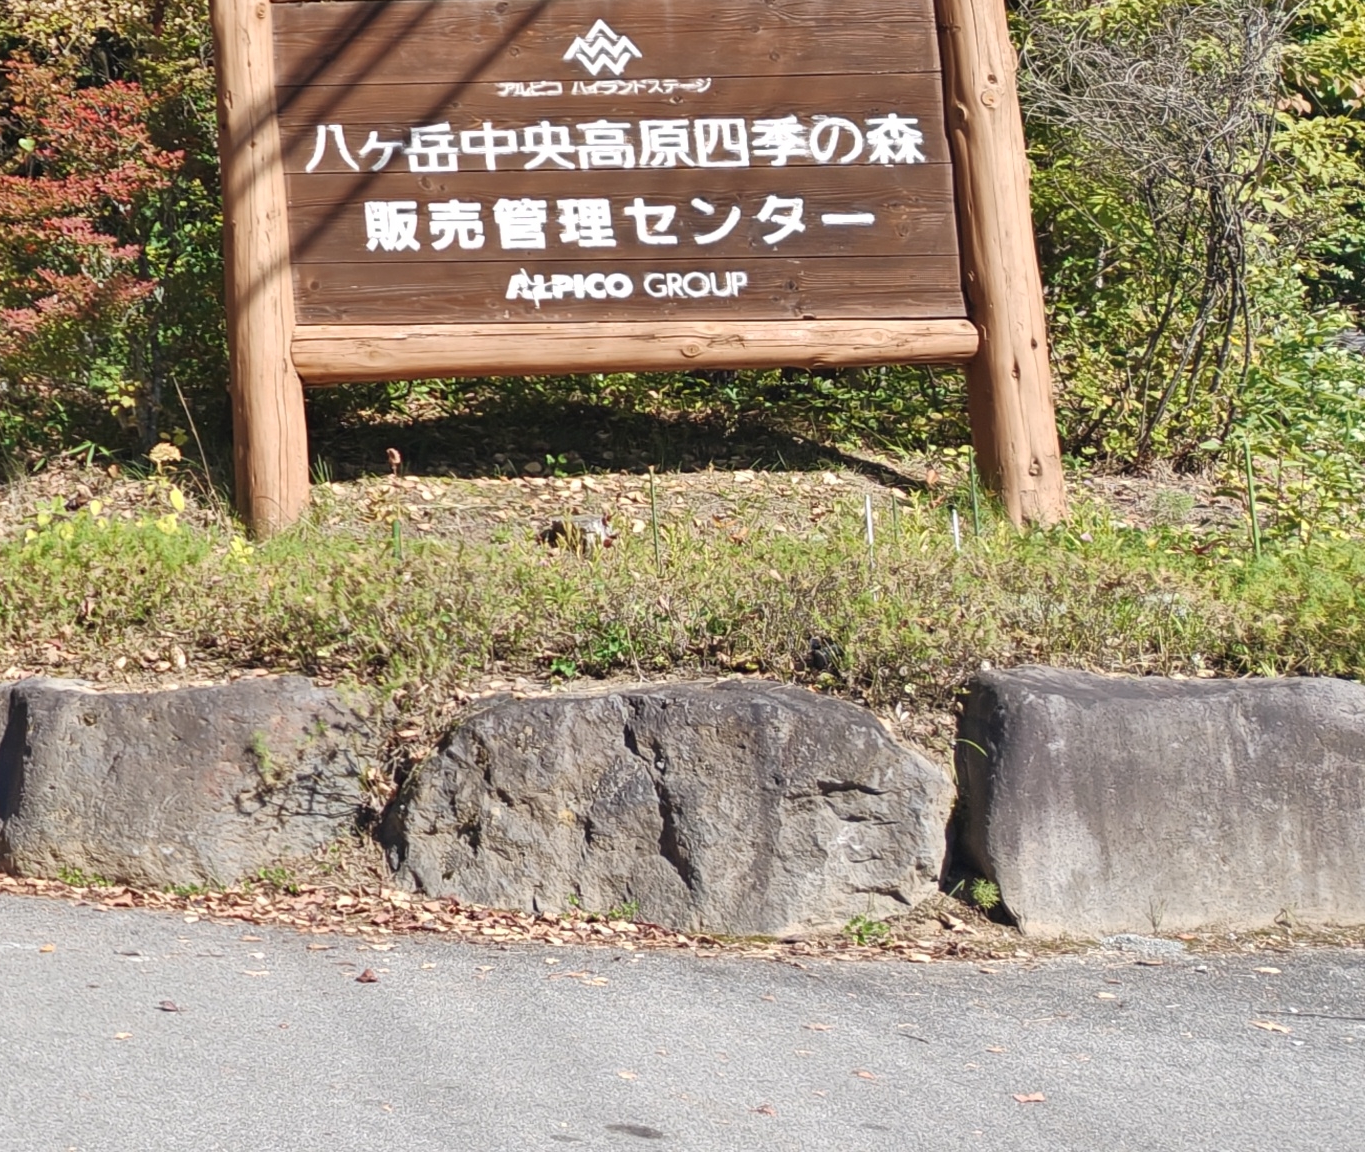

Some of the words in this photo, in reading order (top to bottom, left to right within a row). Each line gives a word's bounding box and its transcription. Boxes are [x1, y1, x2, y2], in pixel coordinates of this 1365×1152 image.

[495, 80, 564, 97] アルピコ
[571, 77, 712, 96] ハイランドステージ
[364, 195, 876, 252] 販売管理センター
[505, 269, 634, 306] ALPICO
[643, 271, 749, 299] GROUP
